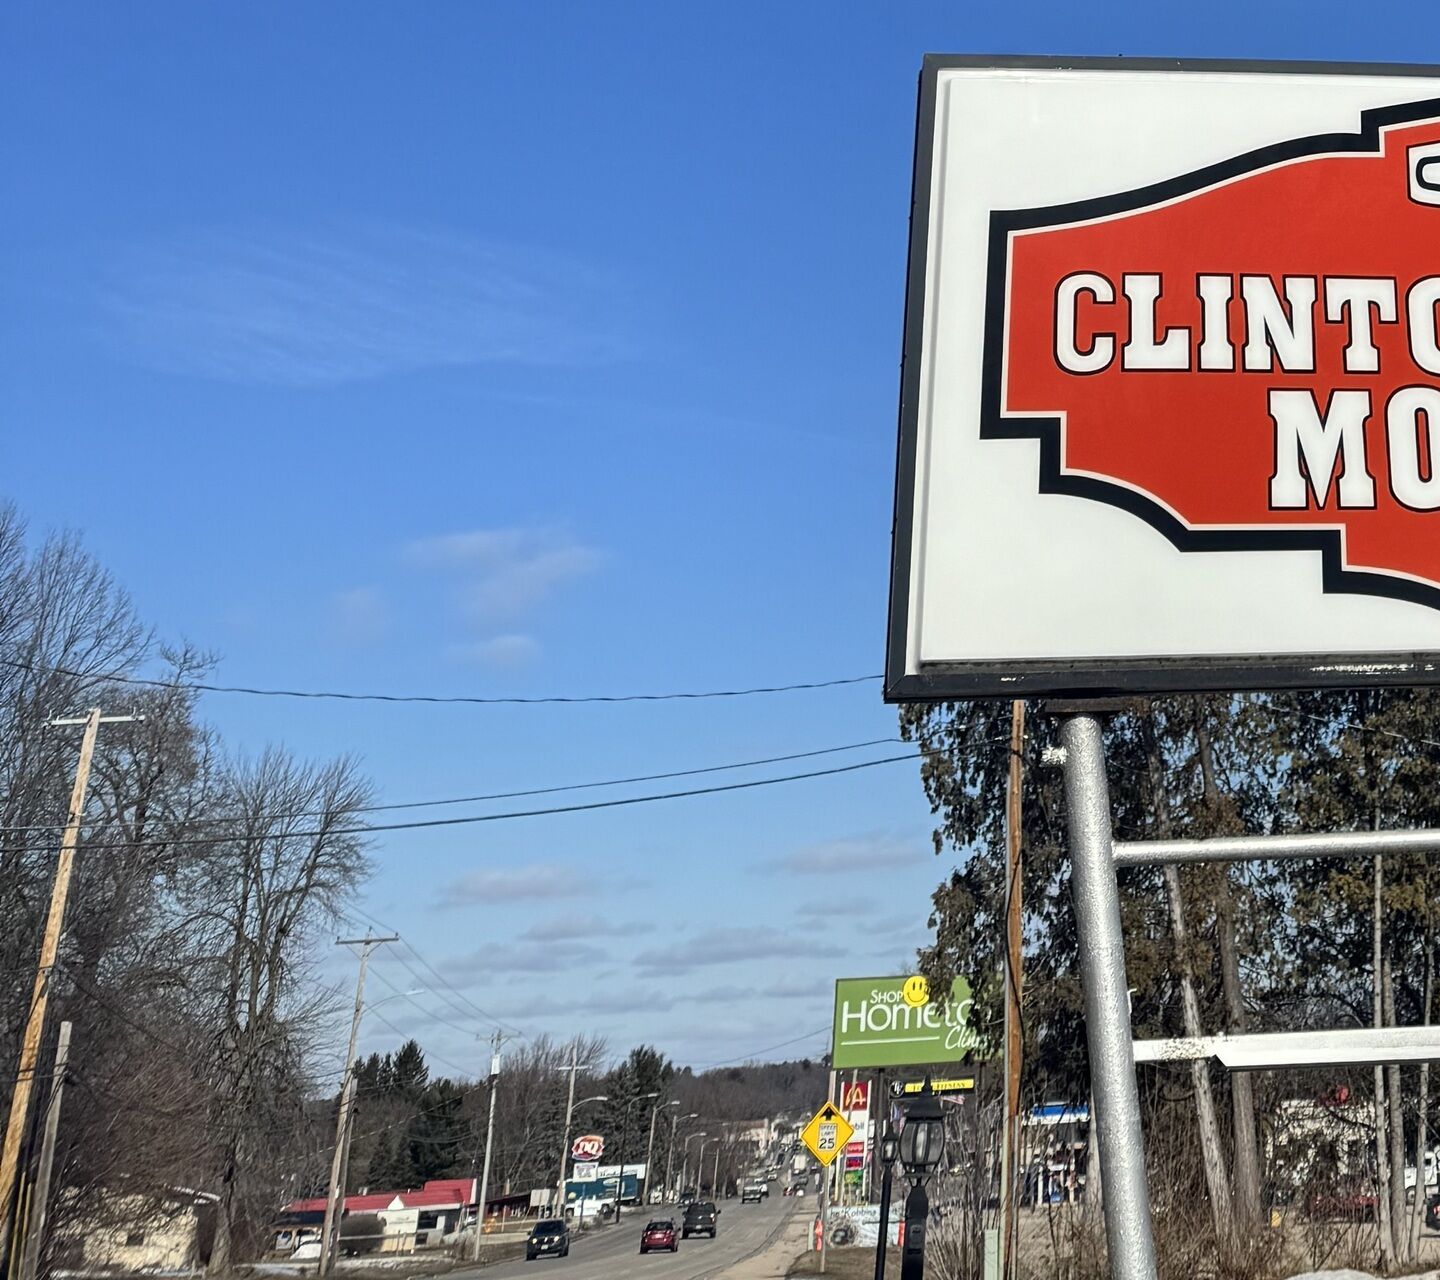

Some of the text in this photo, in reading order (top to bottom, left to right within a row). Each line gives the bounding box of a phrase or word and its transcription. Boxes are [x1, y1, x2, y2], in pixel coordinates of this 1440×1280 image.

[870, 989, 903, 1004] SHOP
[841, 998, 976, 1033] Hometo
[819, 1138, 835, 1150] 25
